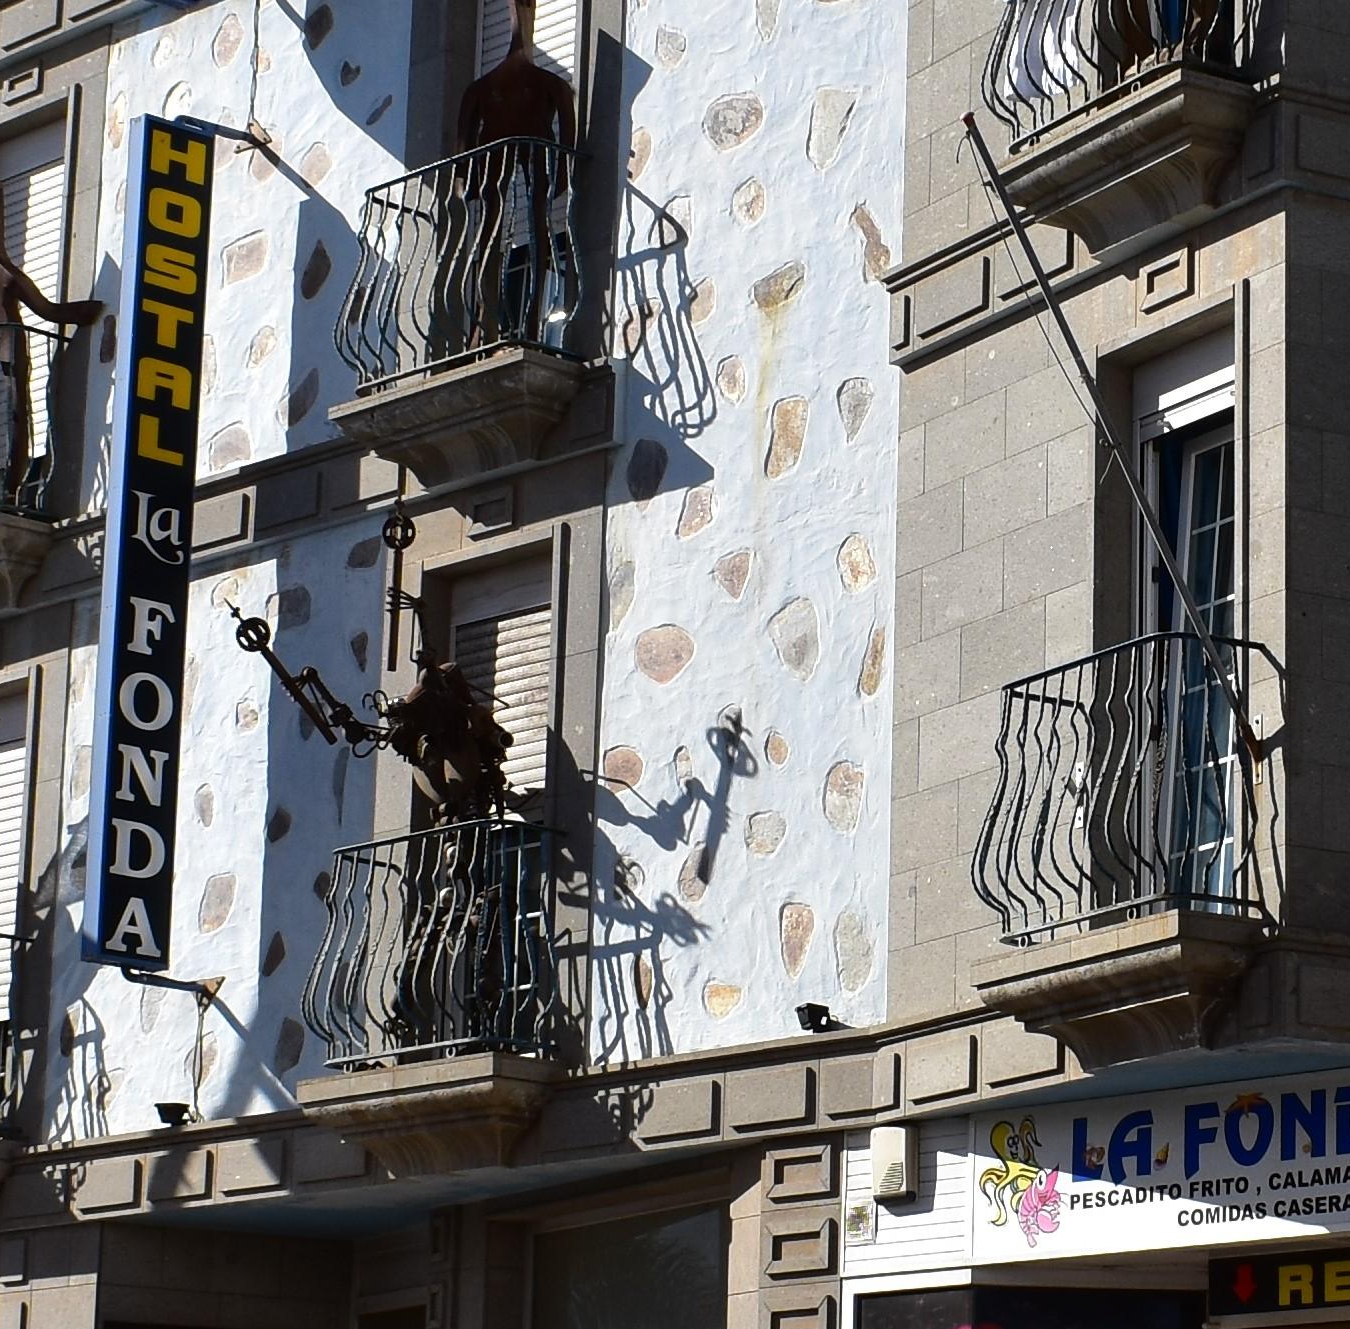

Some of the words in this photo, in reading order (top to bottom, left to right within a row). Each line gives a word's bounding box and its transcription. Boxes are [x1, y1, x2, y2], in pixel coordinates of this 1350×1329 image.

[137, 129, 208, 467] HOSTAL
[105, 595, 176, 959] FONDA
[1071, 1109, 1155, 1185] LA
[1069, 1183, 1183, 1210] PESCADITO
[1188, 1175, 1250, 1199] FRITO
[1176, 1202, 1268, 1227] COMIDAS
